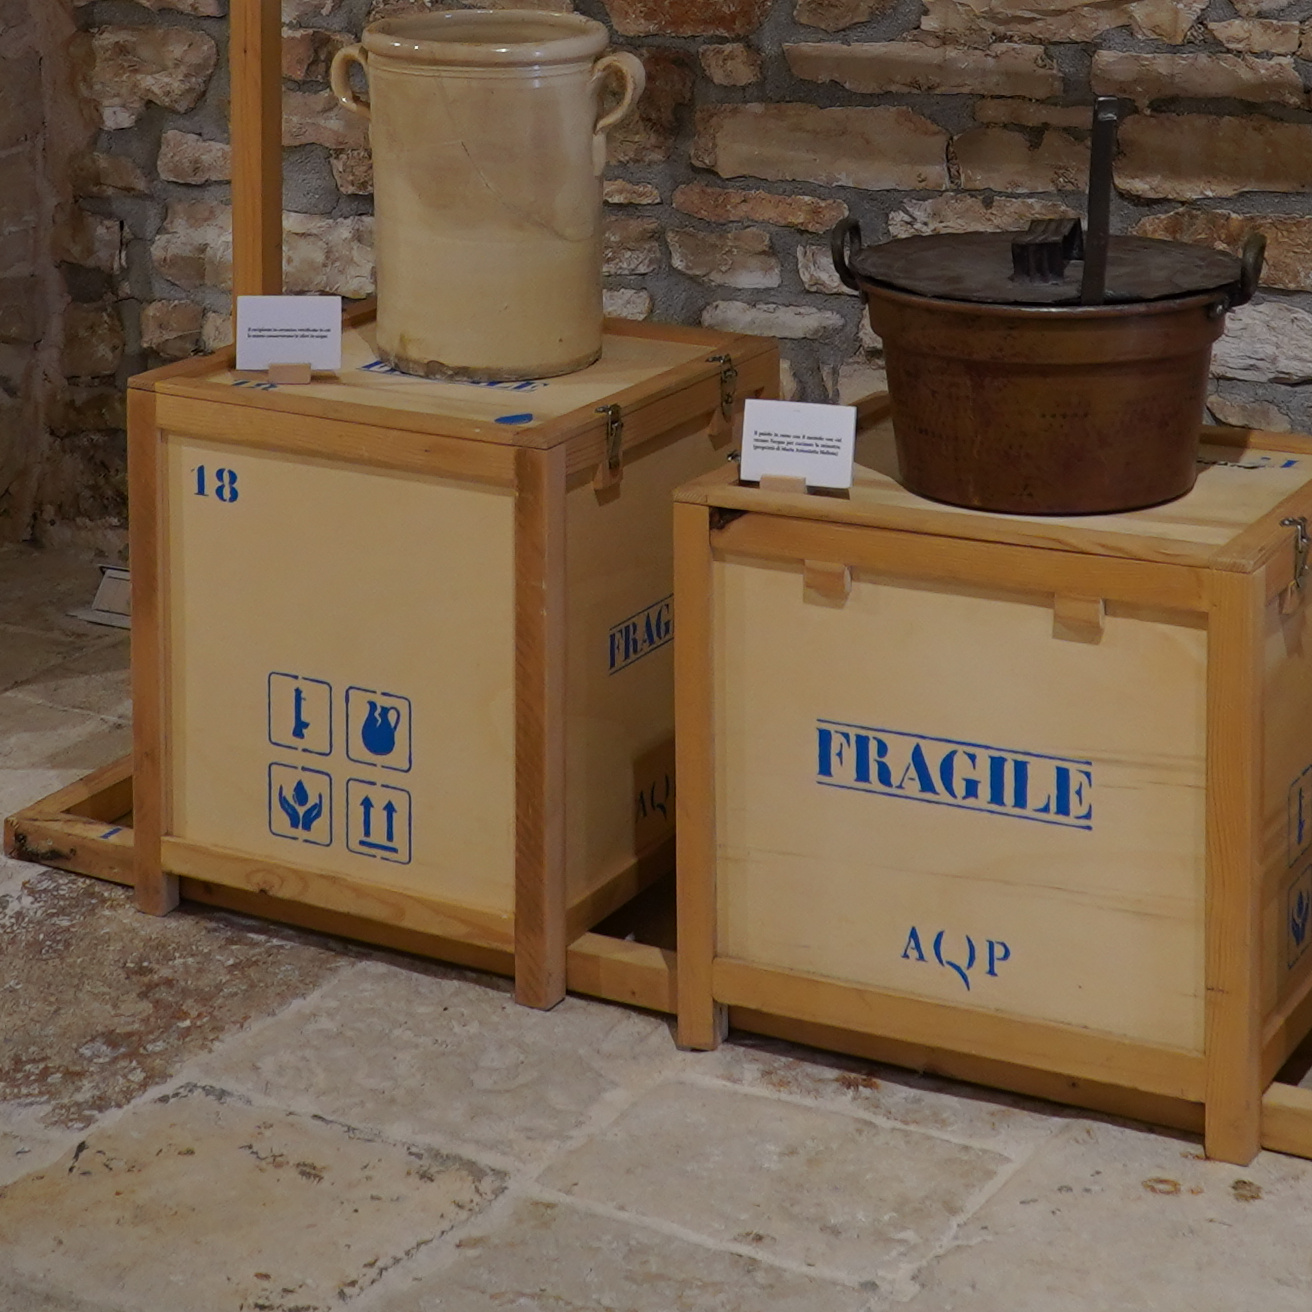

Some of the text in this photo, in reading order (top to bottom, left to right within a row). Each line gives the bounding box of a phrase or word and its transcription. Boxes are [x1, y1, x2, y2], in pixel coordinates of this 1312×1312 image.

[191, 464, 240, 503] 18
[608, 602, 675, 671] FRAG
[816, 727, 1092, 821] FRAGILE
[901, 926, 1011, 991] AQP
